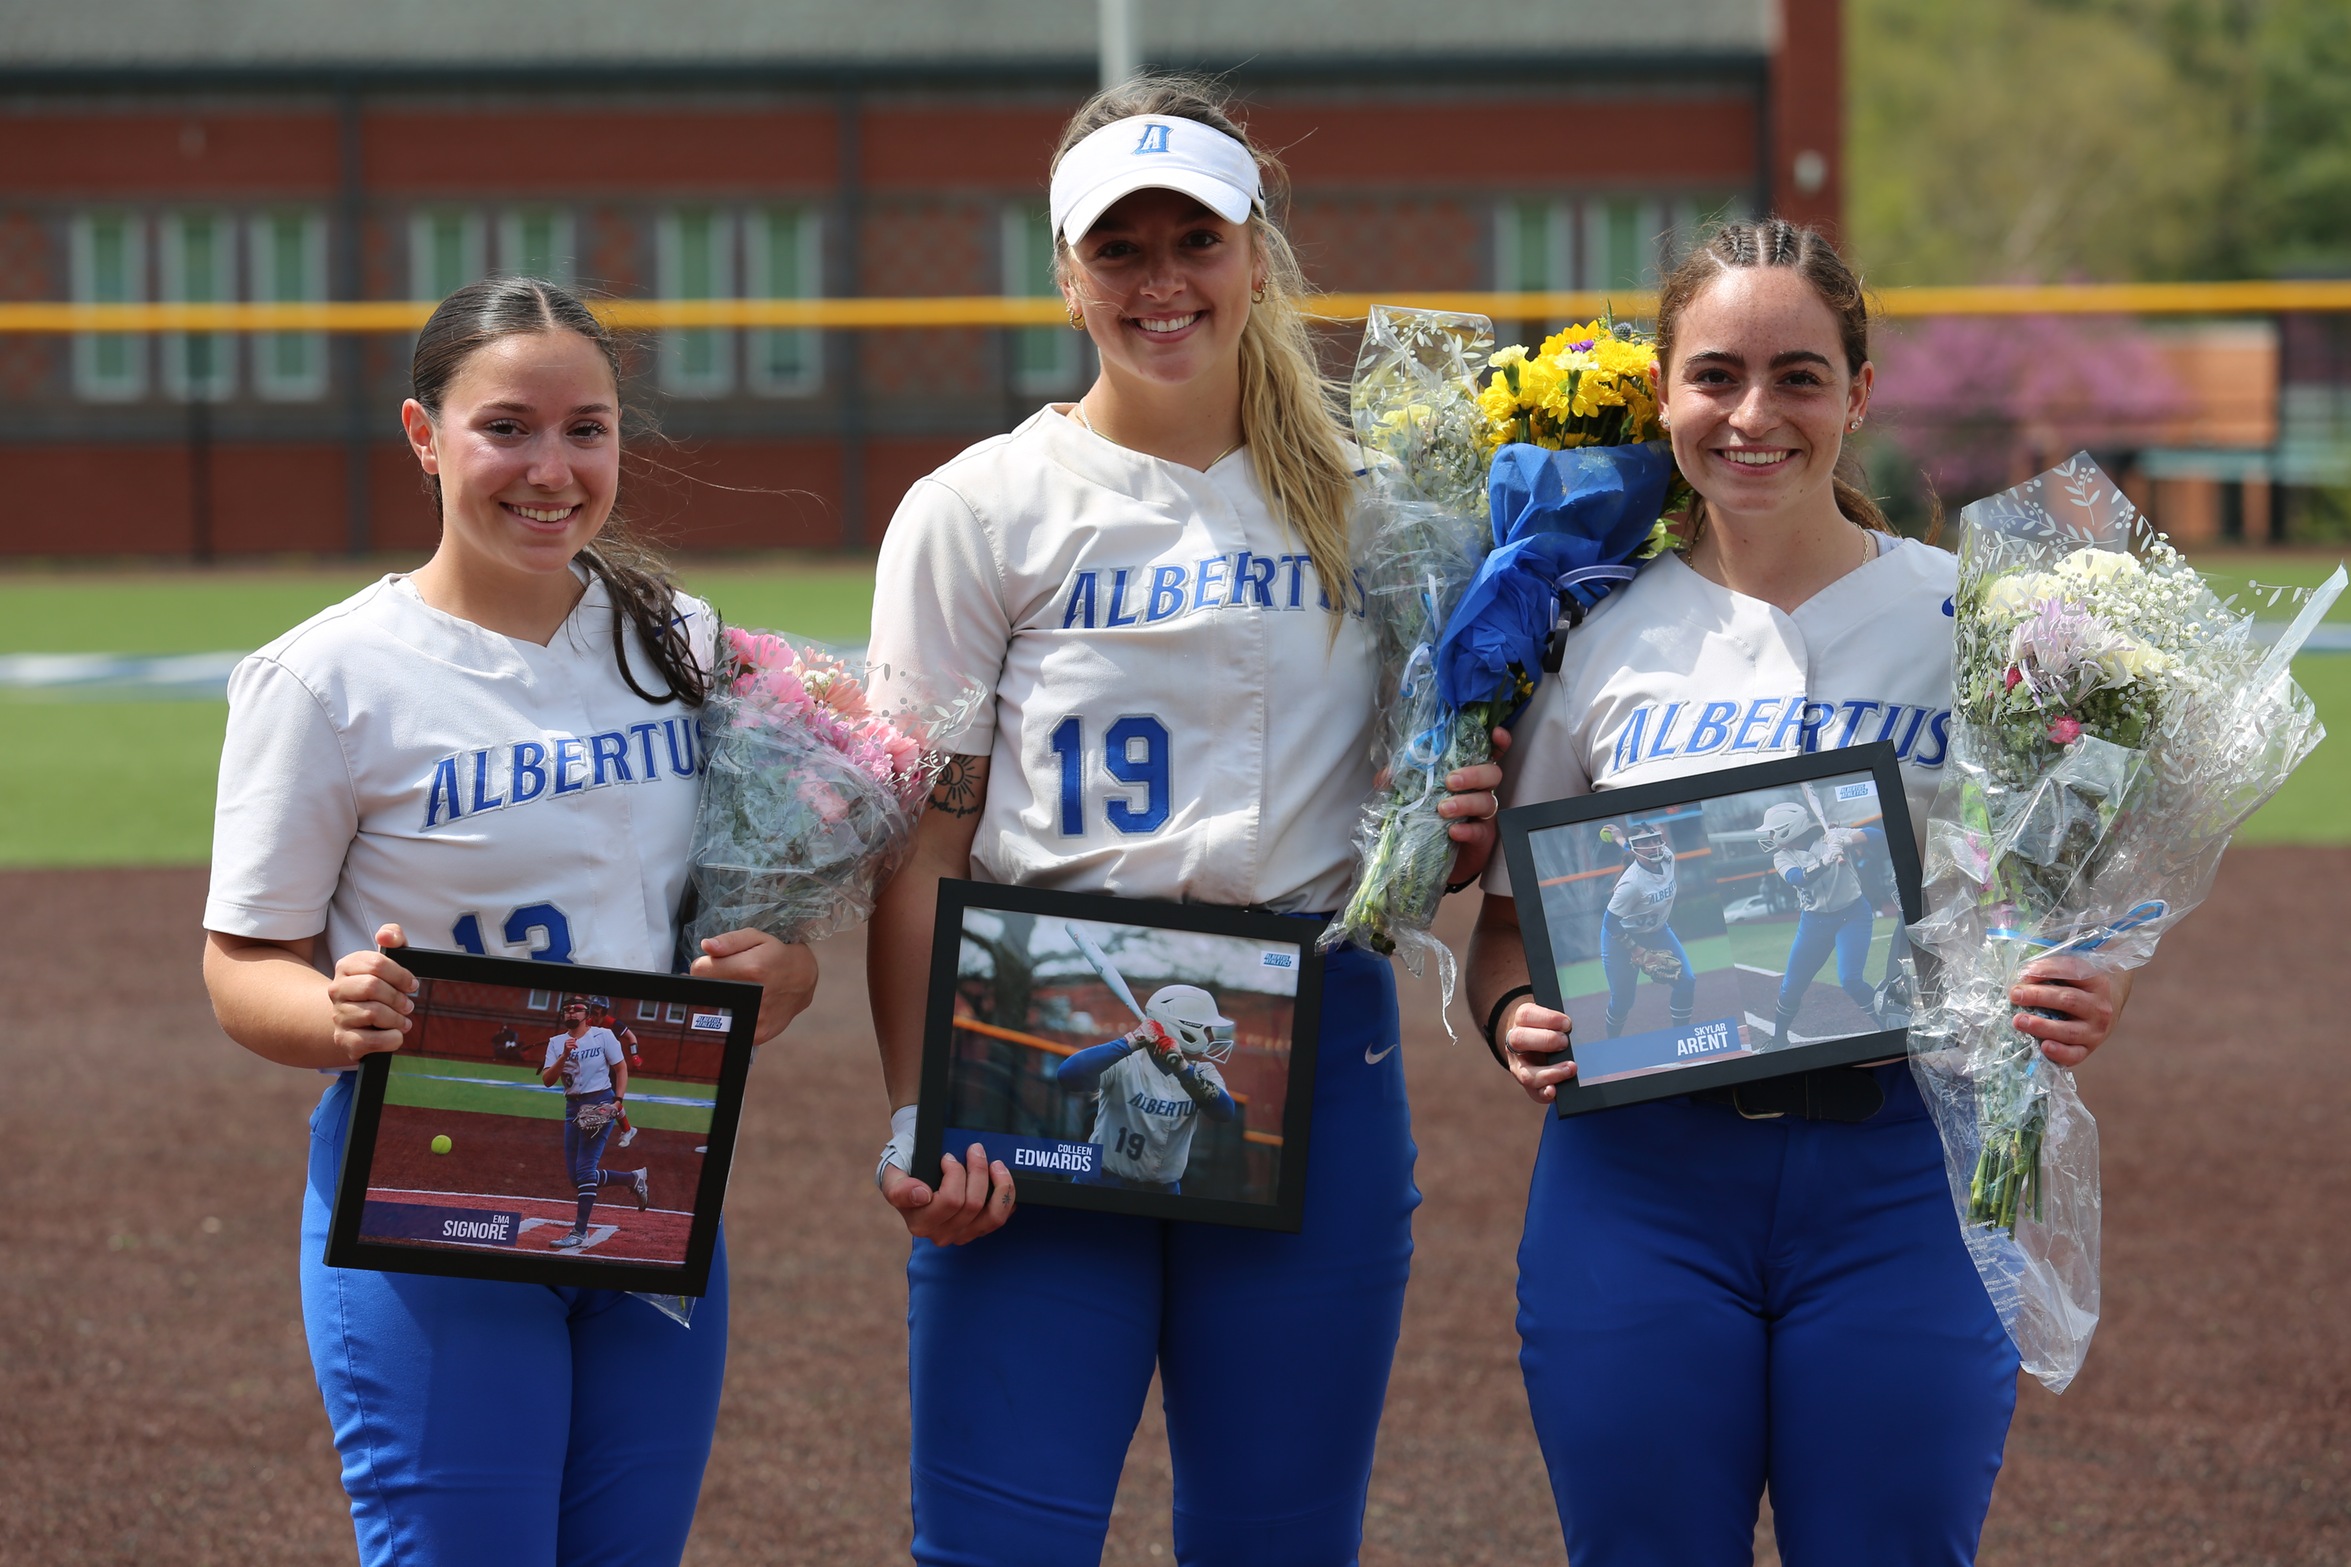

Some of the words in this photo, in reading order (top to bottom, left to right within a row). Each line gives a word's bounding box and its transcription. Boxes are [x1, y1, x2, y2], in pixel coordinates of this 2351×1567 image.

[1607, 696, 1951, 778] ALBERTUS
[1048, 713, 1175, 840] 19
[1694, 1022, 1727, 1037] SKYLAR
[1677, 1031, 1728, 1056] ARENT
[1057, 1143, 1092, 1156] COLLEEN
[1115, 1127, 1146, 1161] 19
[1014, 1148, 1092, 1172] EDWARDS
[442, 1220, 509, 1241] SIGNORE
[492, 1214, 510, 1225] EMA
